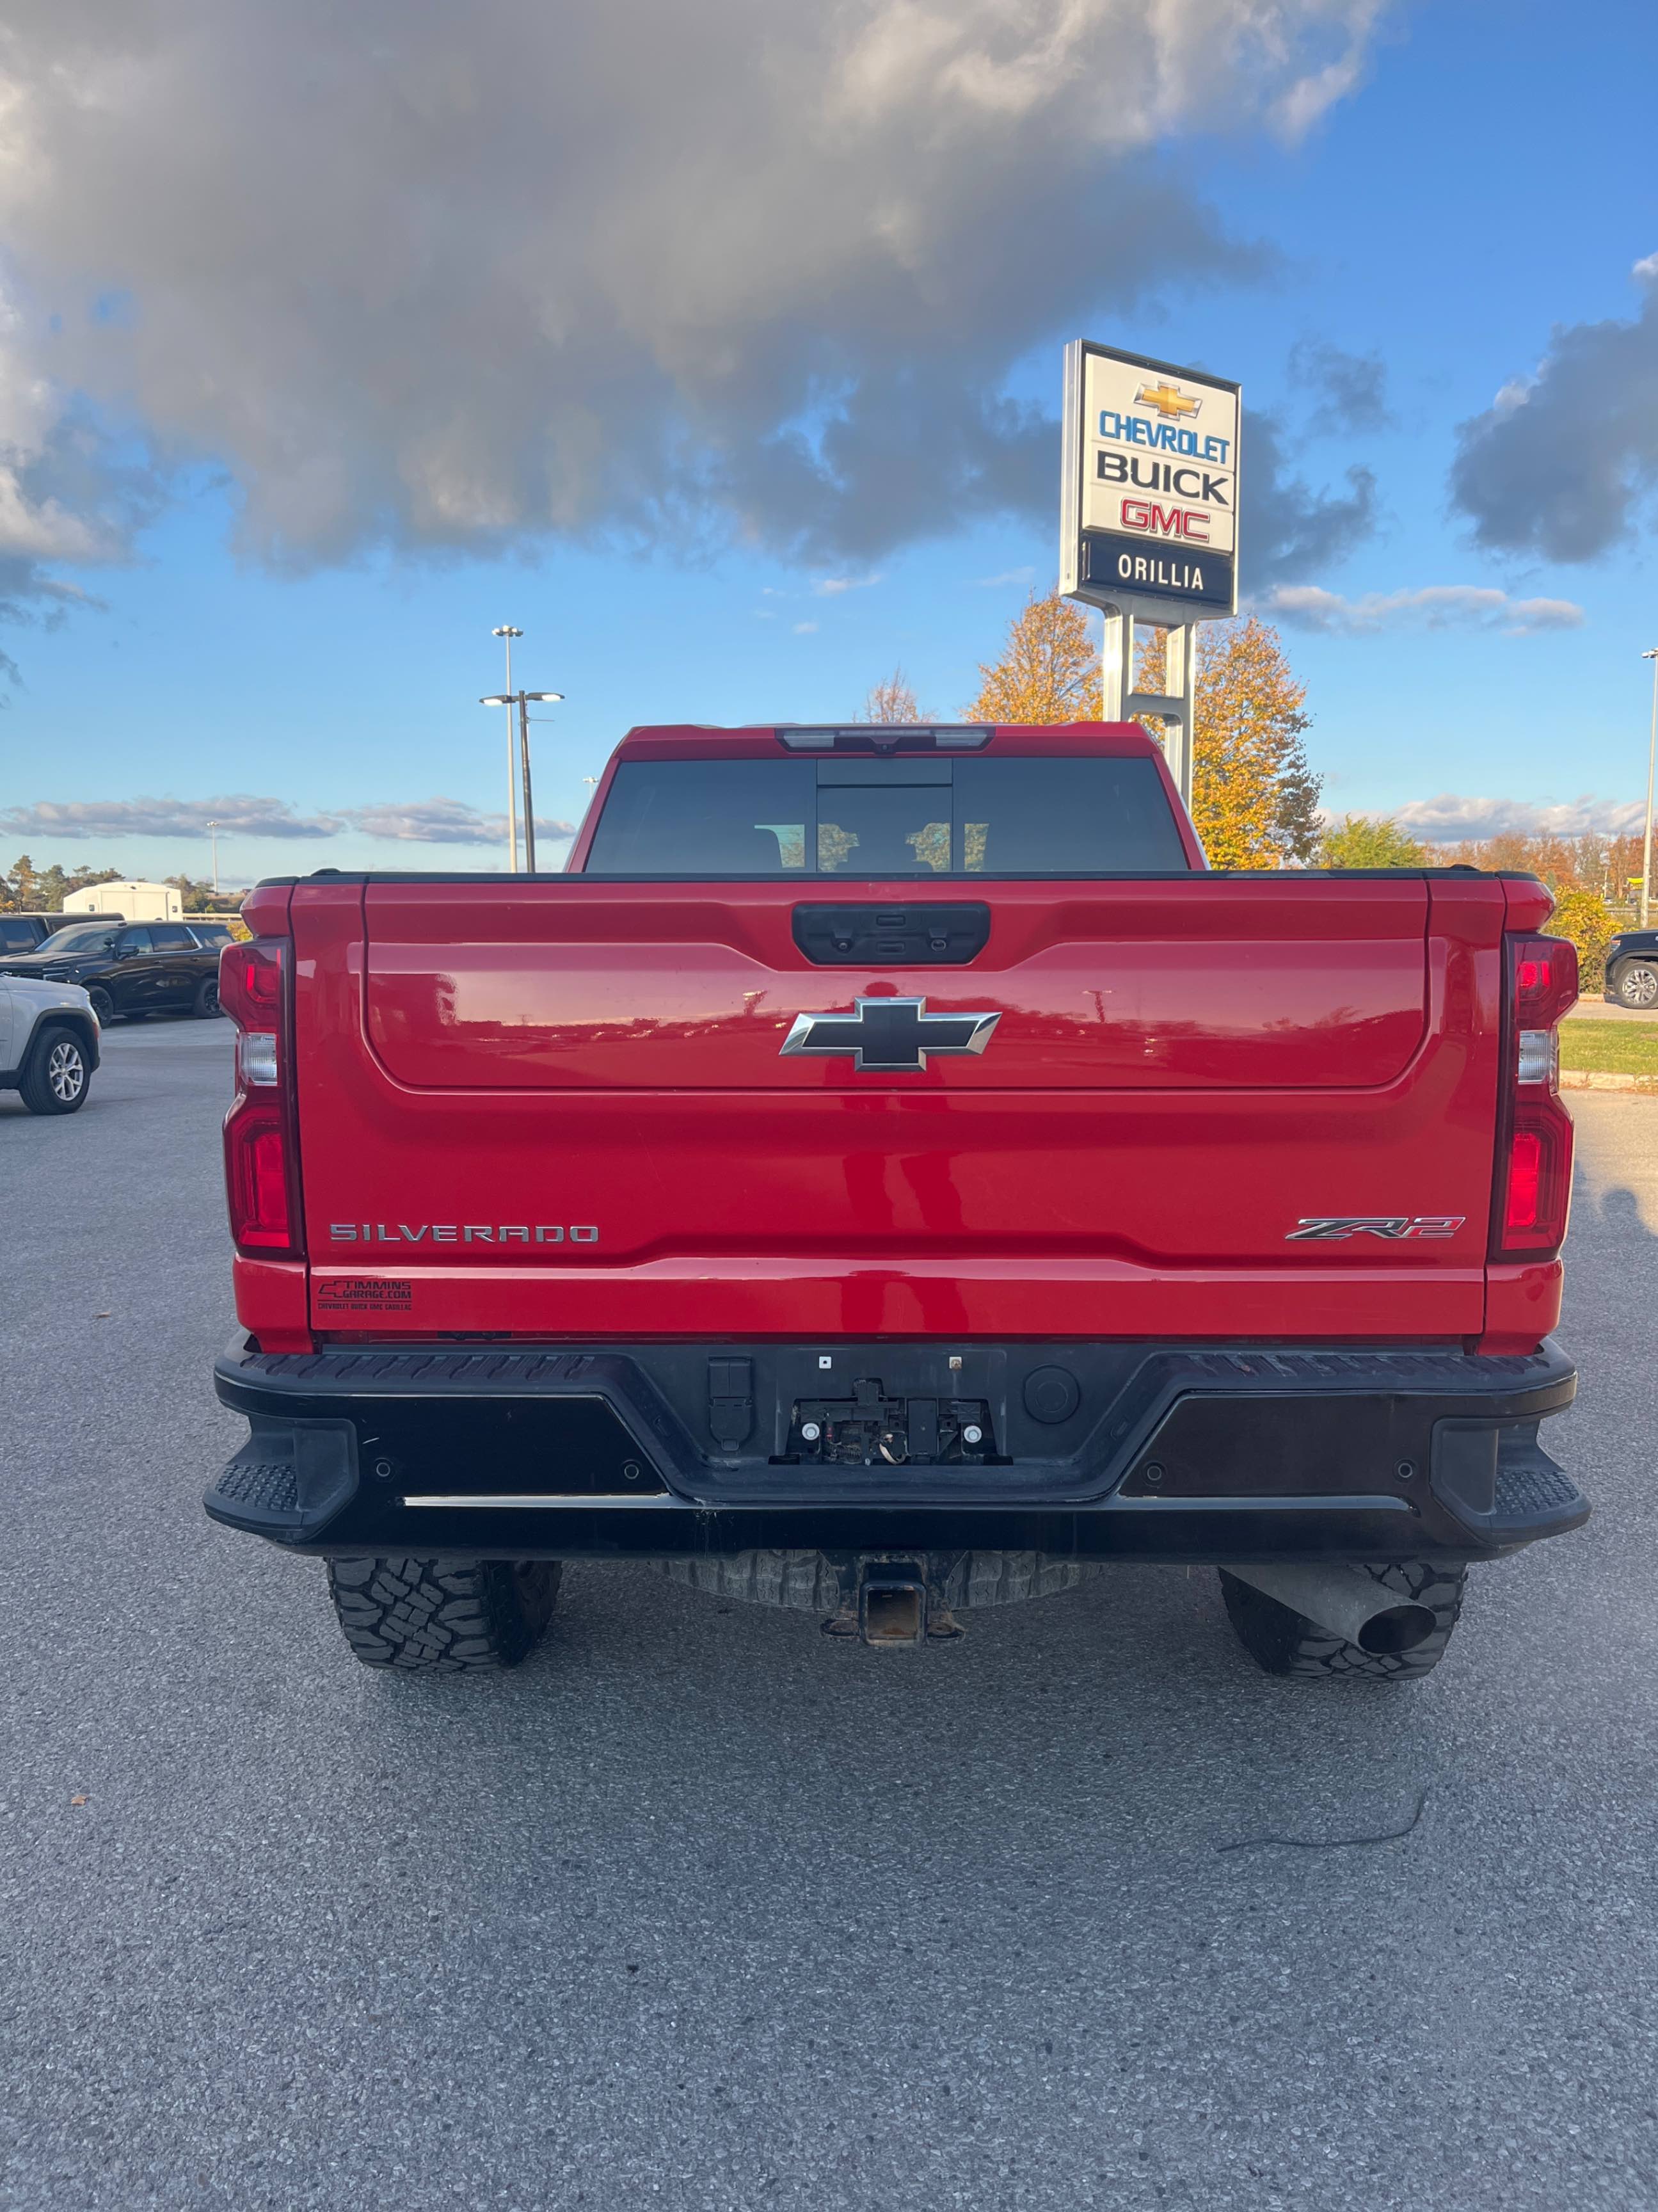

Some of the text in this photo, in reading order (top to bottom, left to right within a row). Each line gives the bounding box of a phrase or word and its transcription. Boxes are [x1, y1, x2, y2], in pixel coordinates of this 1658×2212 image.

[1099, 410, 1229, 464] CHEVROLET
[1097, 450, 1229, 505] BUICK
[1121, 497, 1209, 542] GMC
[1118, 554, 1203, 590] ORILLIA
[330, 1224, 599, 1243] SILVERADO
[1285, 1217, 1465, 1240] ZR2
[343, 1281, 411, 1290] TIMMINS
[343, 1290, 411, 1299] GARAGE.COM
